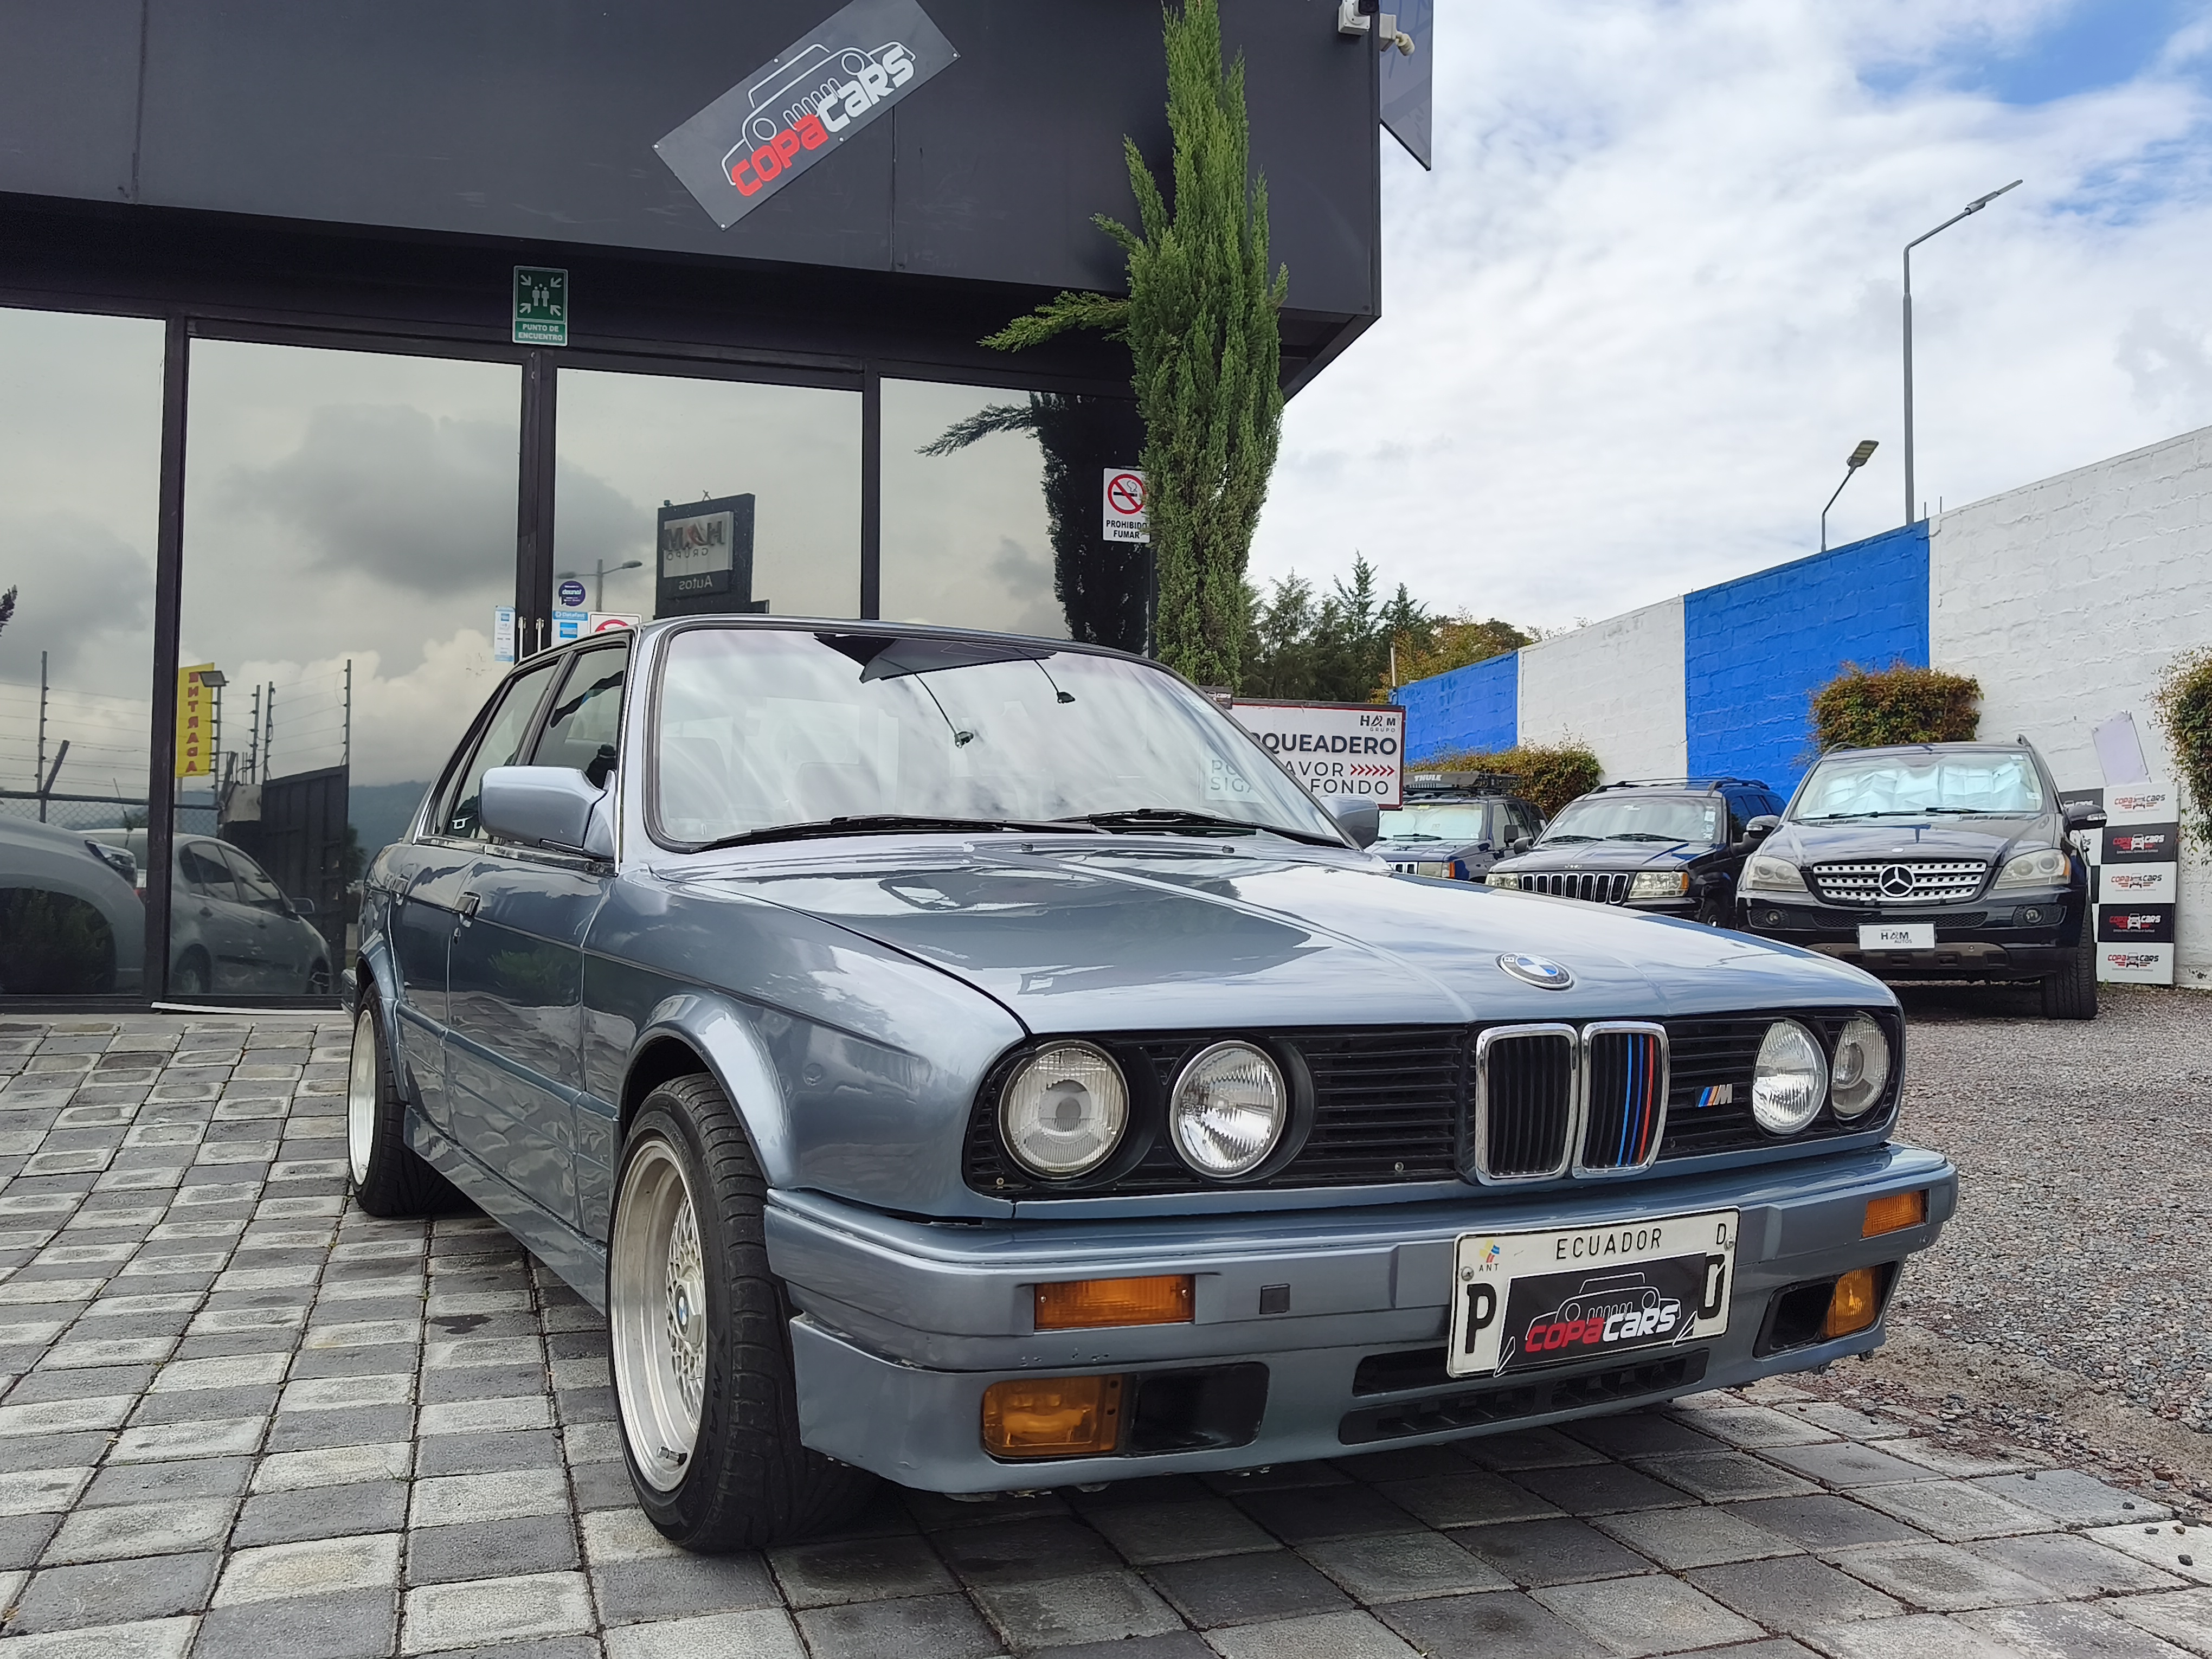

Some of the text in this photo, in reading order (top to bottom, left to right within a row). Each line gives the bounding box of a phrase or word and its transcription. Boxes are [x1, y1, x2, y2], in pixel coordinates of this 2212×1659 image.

[518, 332, 563, 340] ENCUENTRO
[1106, 519, 1147, 529] PROHIBIDO
[1113, 530, 1140, 539] FUMAR
[1211, 776, 1388, 795] SIG FONDO
[1713, 1084, 1733, 1105] M
[1557, 1223, 1726, 1259] ECUADOR D
[1479, 1263, 1500, 1272] ANT
[1465, 1282, 1497, 1354] P
